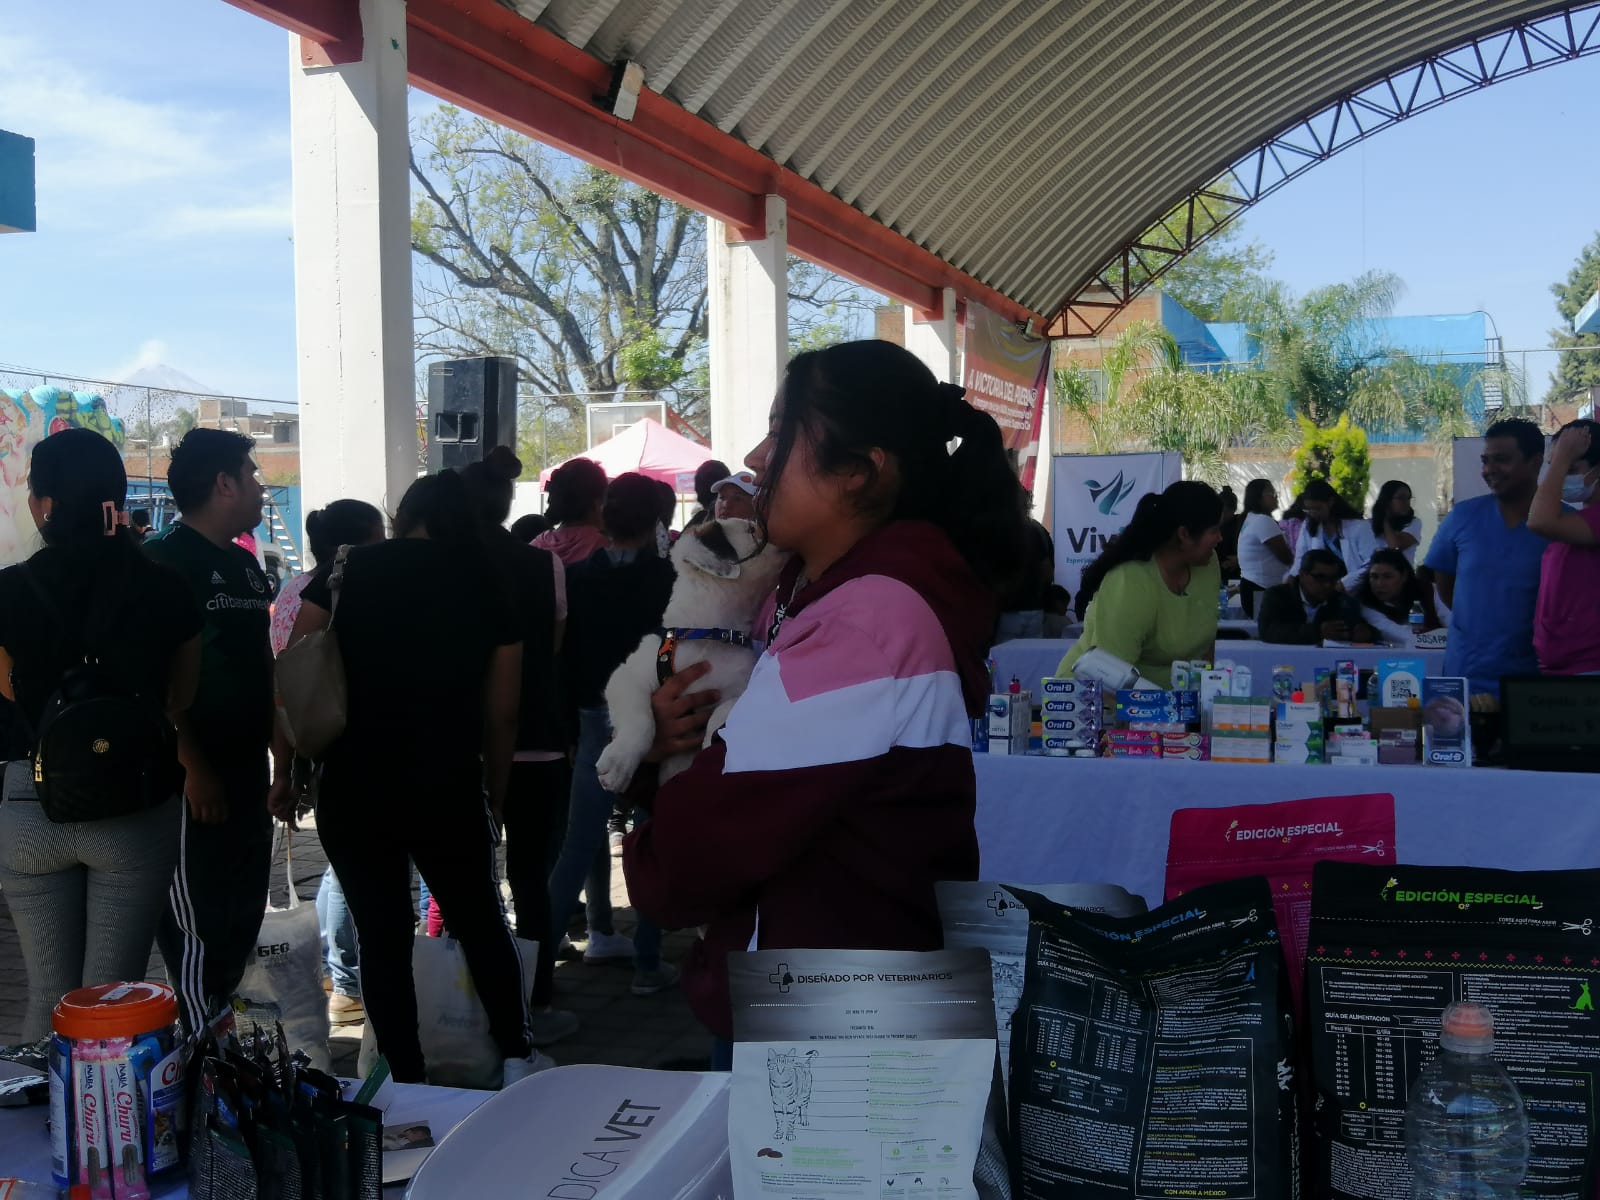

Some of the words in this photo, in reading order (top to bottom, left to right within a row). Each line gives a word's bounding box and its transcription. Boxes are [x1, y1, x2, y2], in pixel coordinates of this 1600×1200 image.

[975, 371, 1003, 399] VICTORIA
[1003, 381, 1014, 402] DEL
[1046, 682, 1072, 692] Oral-B
[1046, 701, 1073, 711] Oral-B
[1046, 720, 1072, 729] Oral-B
[1432, 751, 1462, 762] Oral-B
[1235, 825, 1284, 841] EDICIÓN
[1286, 821, 1341, 837] ESPECIAL
[1395, 888, 1461, 904] EDICIÓN
[1464, 892, 1542, 906] ESPECIAL
[1133, 906, 1204, 937] ESPECIAL
[797, 972, 851, 985] DISEÑADO
[853, 973, 875, 983] POR
[878, 971, 953, 983] VETERINARIOS
[1349, 1014, 1391, 1022] ALIMENTACIÓN
[87, 1064, 96, 1091] INABA
[83, 1093, 97, 1145] Churu
[116, 1091, 133, 1143] Churu
[1164, 1189, 1179, 1197] CON
[1179, 1189, 1197, 1197] AMOR
[1203, 1189, 1228, 1197] MÉXICO
